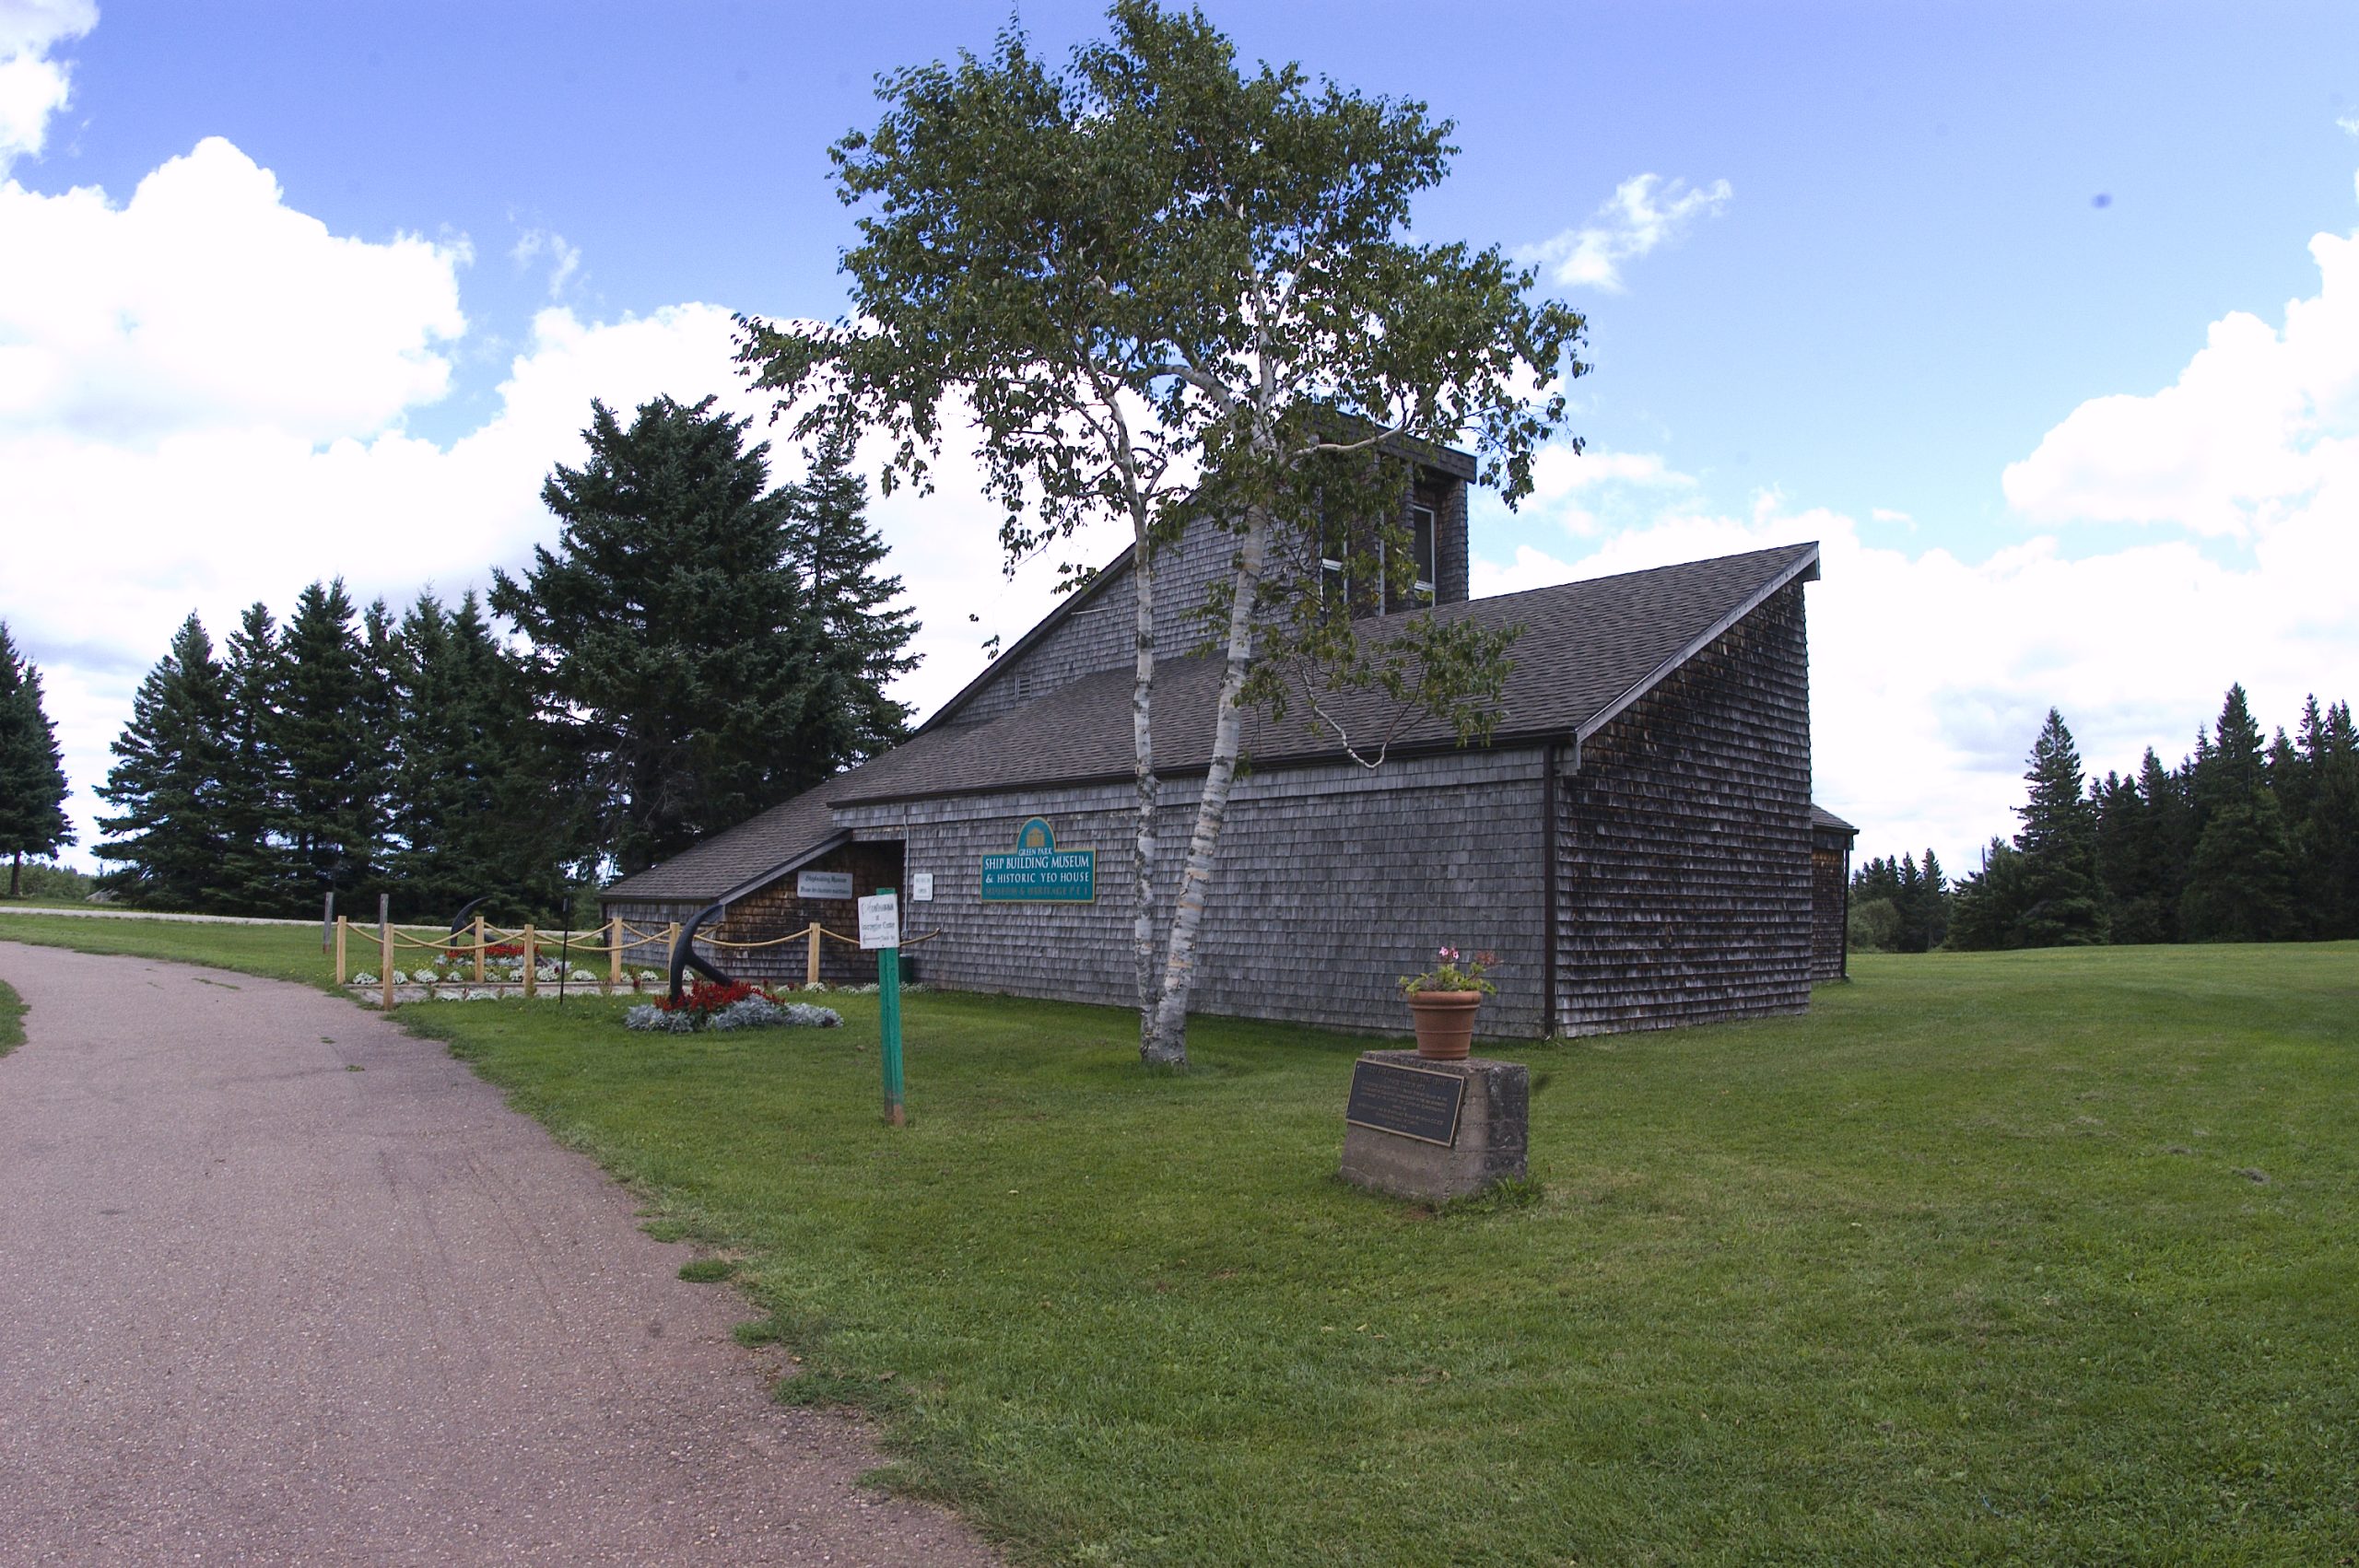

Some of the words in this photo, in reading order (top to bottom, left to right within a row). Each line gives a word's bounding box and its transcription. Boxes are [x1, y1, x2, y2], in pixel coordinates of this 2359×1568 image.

[1018, 848, 1037, 857] GREEN
[1038, 847, 1052, 856] PARK
[985, 858, 1004, 871] SHIP
[1006, 856, 1049, 870] BUILDING
[1051, 855, 1089, 869] MUSEUM
[985, 873, 993, 883] &
[997, 872, 1036, 883] HISTORIC
[1040, 872, 1057, 883] YEO
[1061, 872, 1089, 883] HOUSE
